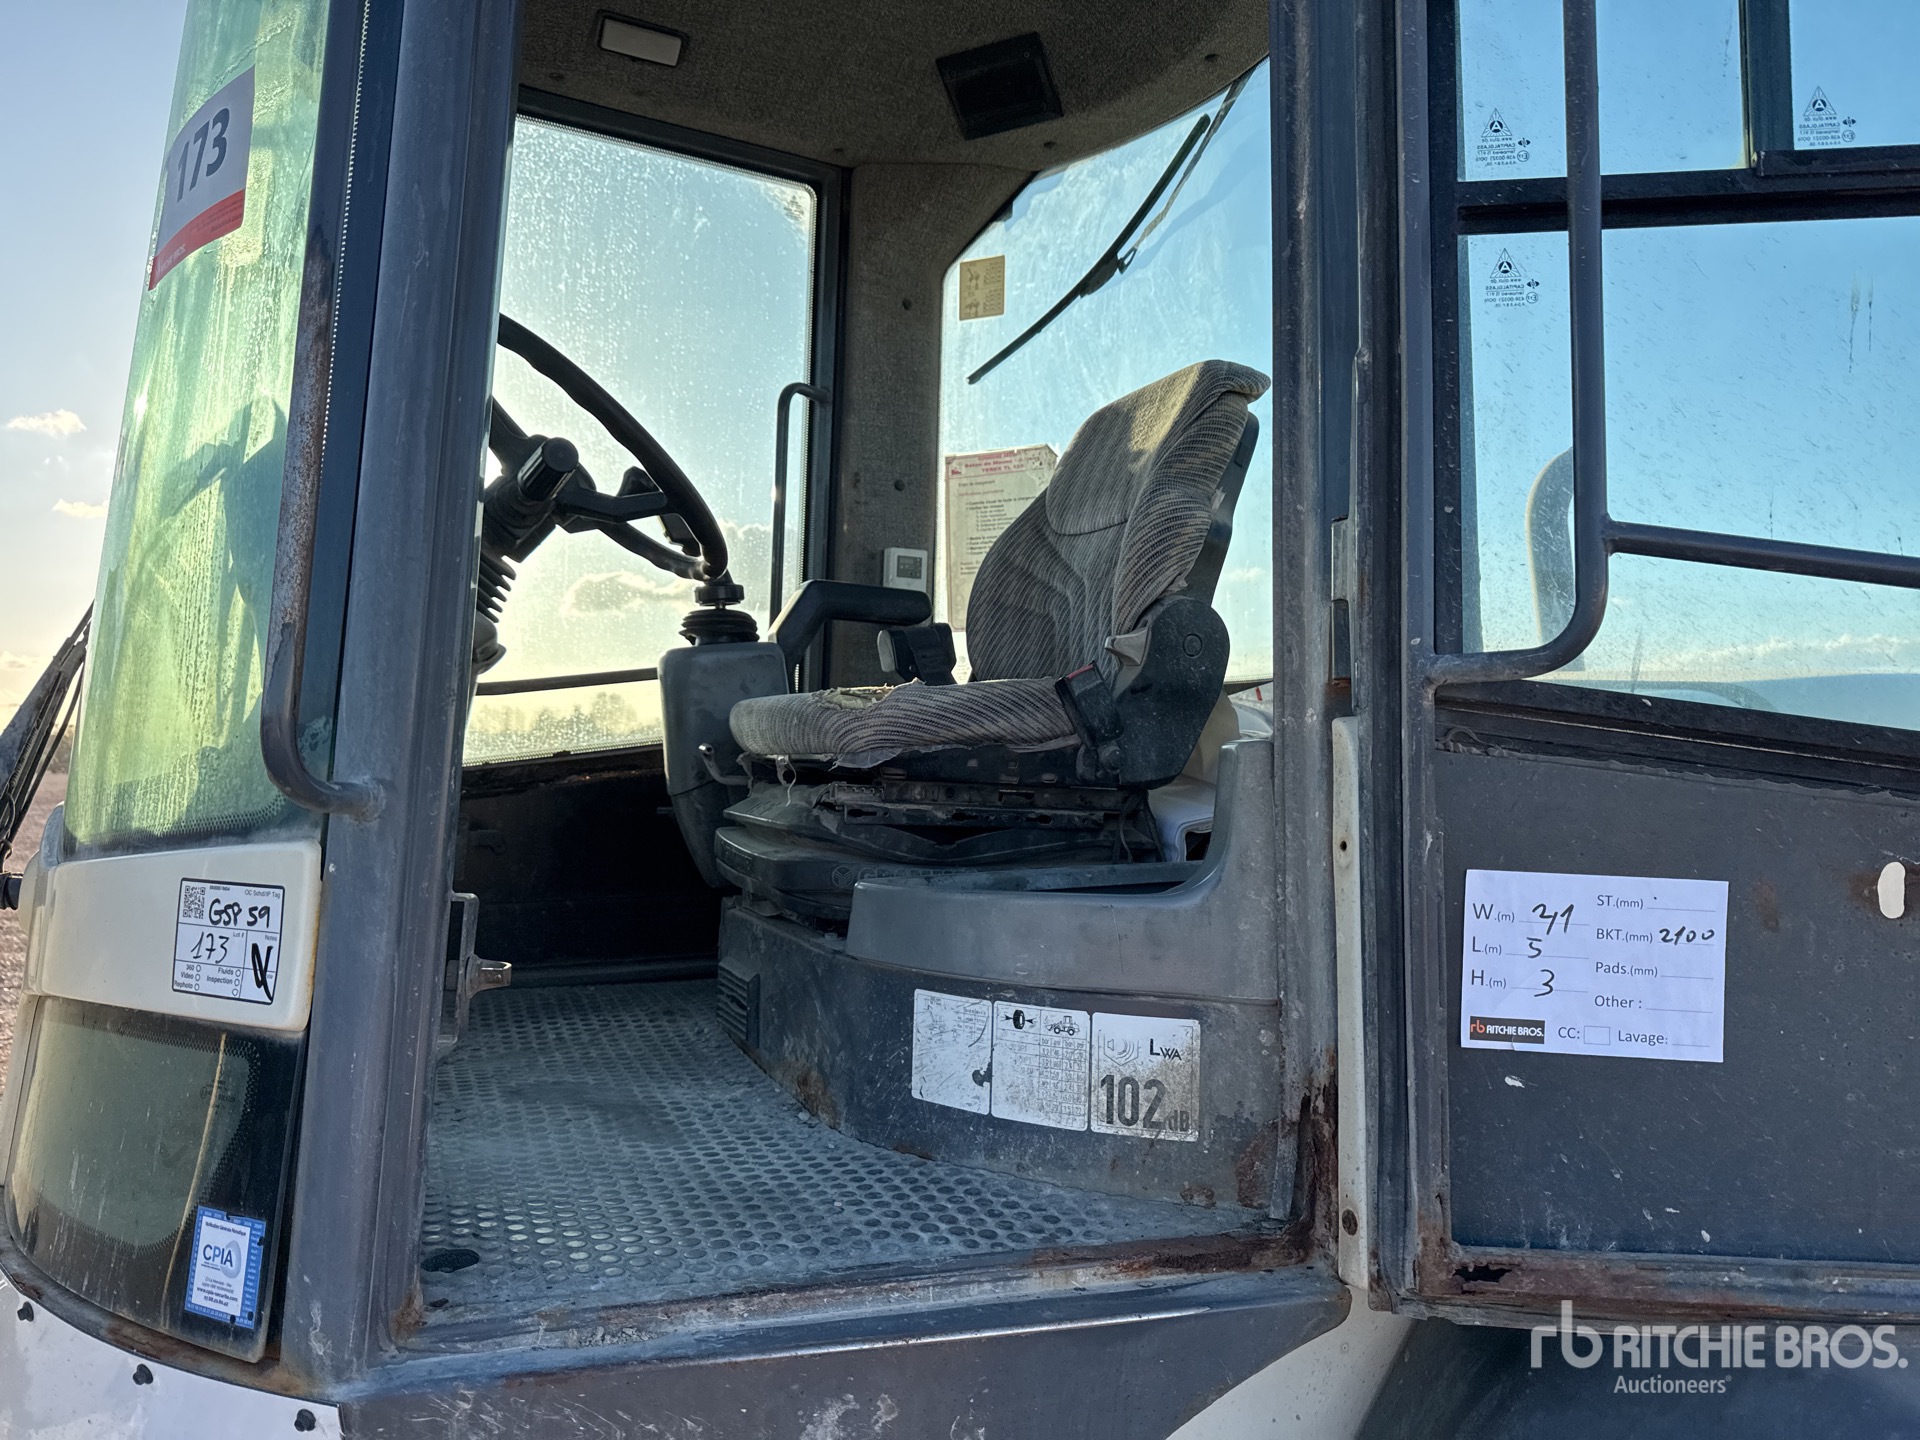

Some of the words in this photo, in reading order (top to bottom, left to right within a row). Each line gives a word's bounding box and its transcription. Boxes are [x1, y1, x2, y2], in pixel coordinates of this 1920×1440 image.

[176, 107, 230, 203] 173
[1597, 895, 1644, 909] ST.(mm)
[247, 906, 270, 928] 59
[1472, 903, 1515, 922] W.(m)
[1472, 936, 1502, 954] L.(m)
[1596, 928, 1653, 943] BKT.(mm)
[190, 932, 230, 964] 173
[1527, 937, 1542, 958] 5
[1471, 969, 1506, 988] H.(m)
[1596, 961, 1658, 977] Pads.(mm)
[207, 976, 233, 984] Inspection
[1534, 970, 1555, 997] 3
[1486, 1025, 1518, 1036] RITCHIE
[1101, 1074, 1166, 1128] 102
[1168, 1110, 1189, 1132] dB
[203, 1244, 233, 1268] CPIA
